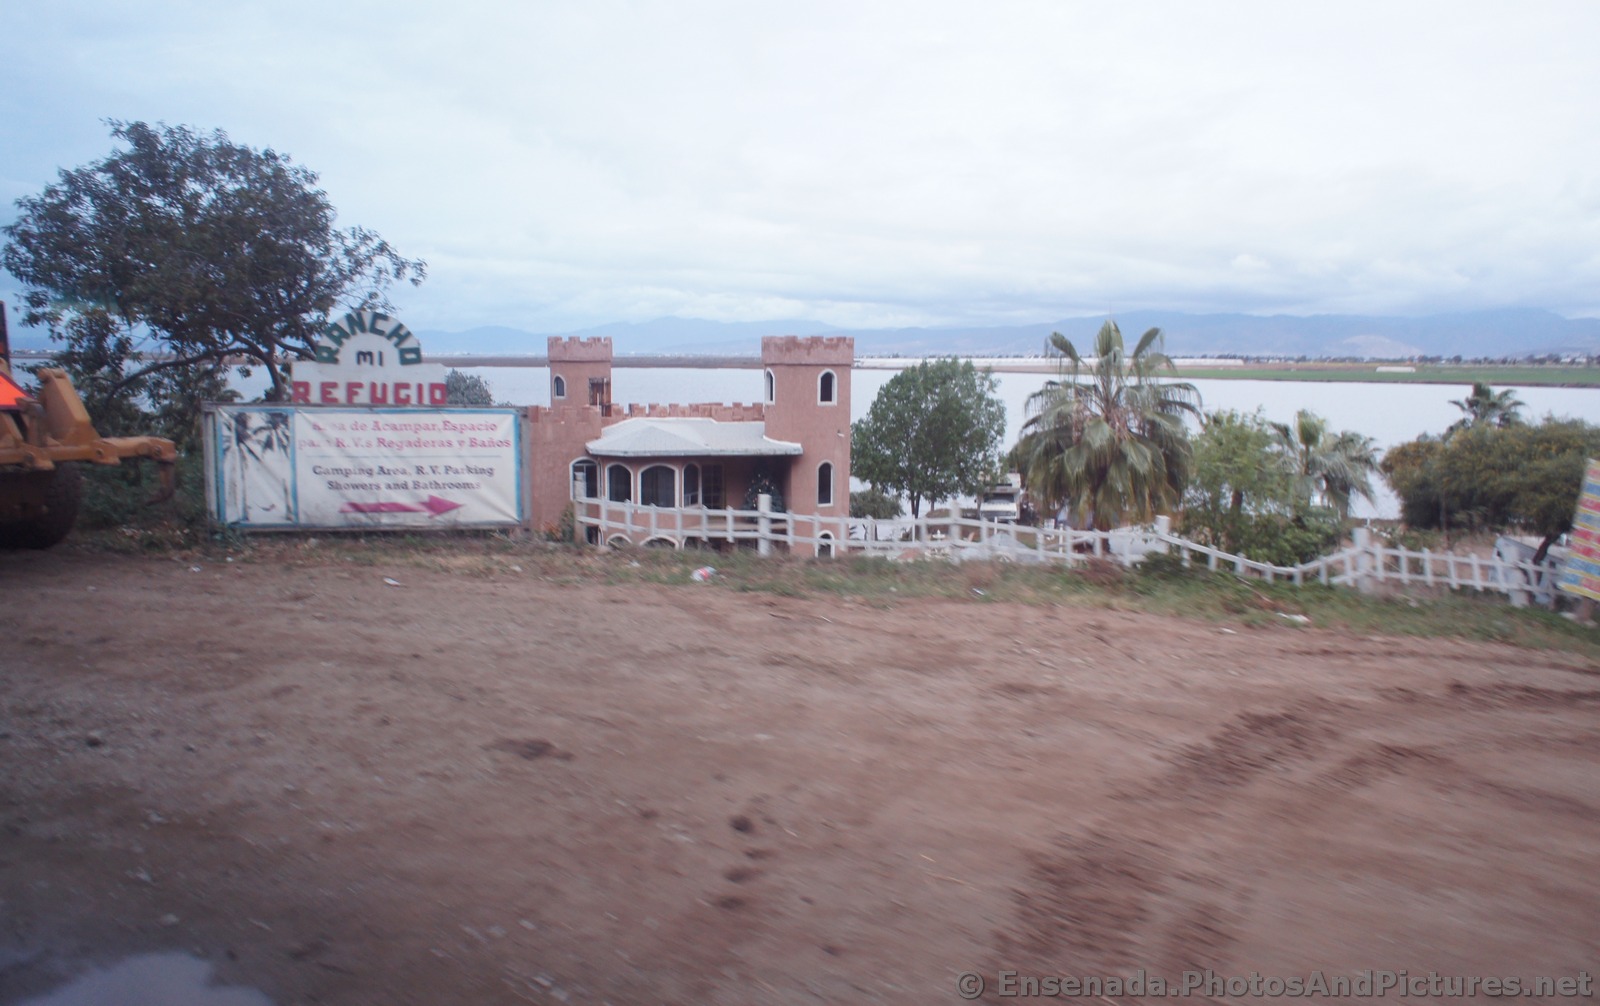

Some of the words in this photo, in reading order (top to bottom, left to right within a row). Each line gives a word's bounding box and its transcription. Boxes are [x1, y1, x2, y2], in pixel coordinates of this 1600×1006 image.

[315, 311, 422, 364] RANCHO
[357, 350, 384, 366] MI
[292, 381, 447, 404] REFUGIO
[351, 420, 368, 431] de
[376, 437, 454, 450] Regaderas
[468, 437, 511, 448] Baños
[312, 465, 374, 478] Camping
[443, 464, 495, 477] Parking
[327, 480, 382, 490] Showers
[384, 480, 409, 490] and
[412, 480, 481, 490] Bathrooms
